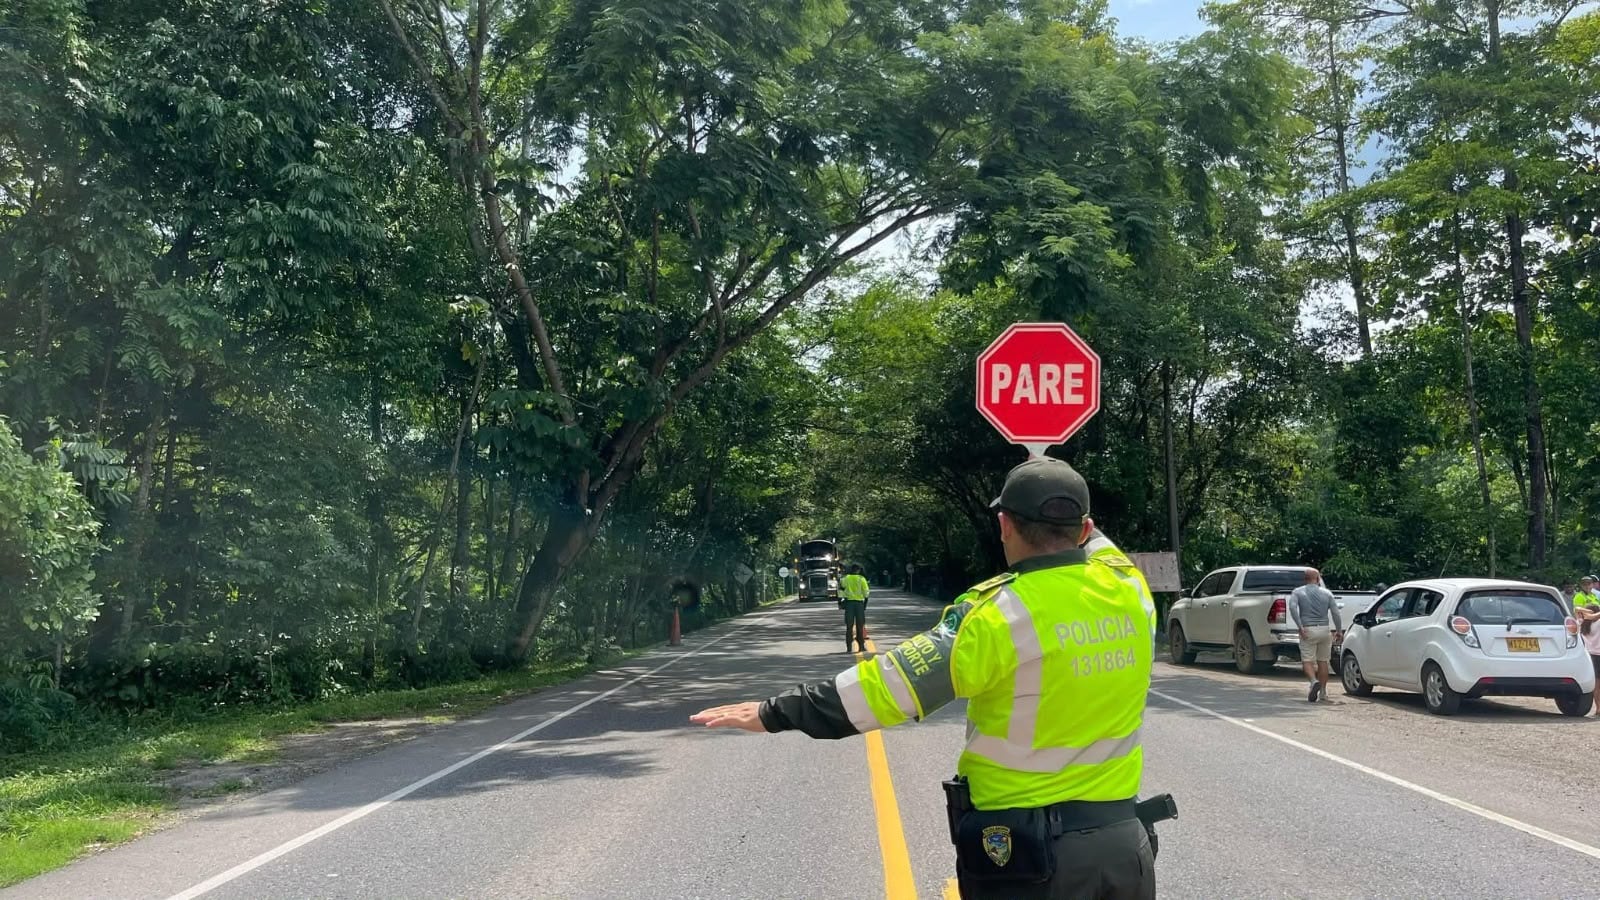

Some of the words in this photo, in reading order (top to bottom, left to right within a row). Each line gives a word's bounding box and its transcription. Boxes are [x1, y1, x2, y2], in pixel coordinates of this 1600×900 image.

[991, 363, 1085, 405] PARE
[1054, 614, 1137, 649] POLICIA
[928, 653, 942, 663] Y
[1071, 647, 1136, 678] 131864
